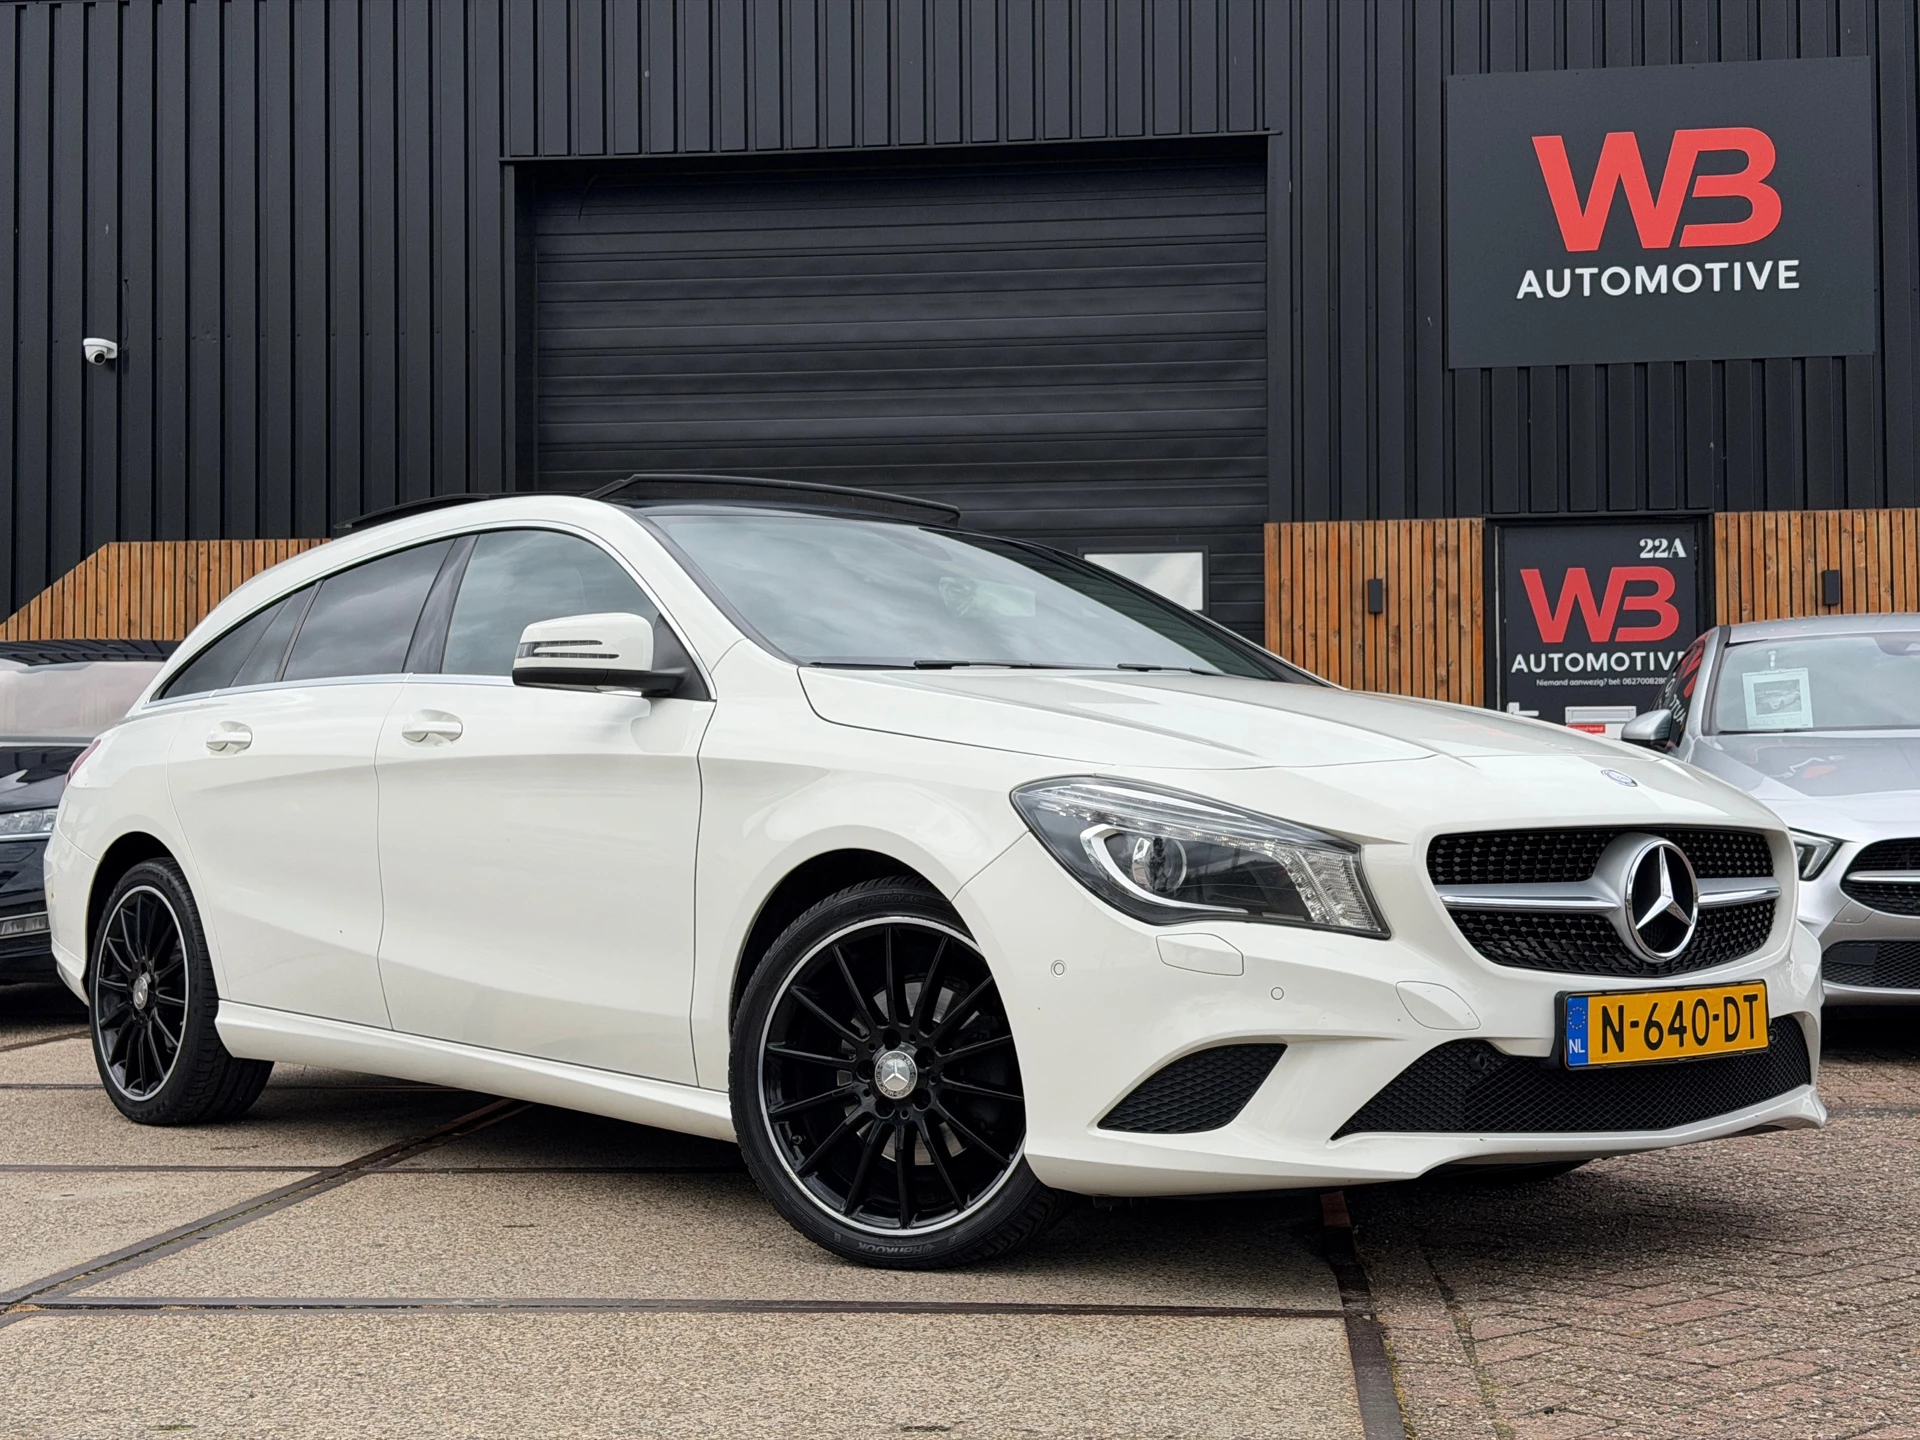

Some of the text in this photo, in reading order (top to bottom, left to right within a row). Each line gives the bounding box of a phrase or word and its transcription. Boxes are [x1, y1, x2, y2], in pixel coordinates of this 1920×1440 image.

[1532, 127, 1782, 252] WB
[1516, 260, 1800, 300] AUTOMOTIVE
[1639, 537, 1687, 559] 22A
[1520, 565, 1680, 643] WB
[1536, 678, 1568, 687] Niemand
[1569, 678, 1608, 688] aanwezig?
[1601, 994, 1758, 1054] N-640-DT
[1568, 1038, 1585, 1055] NL
